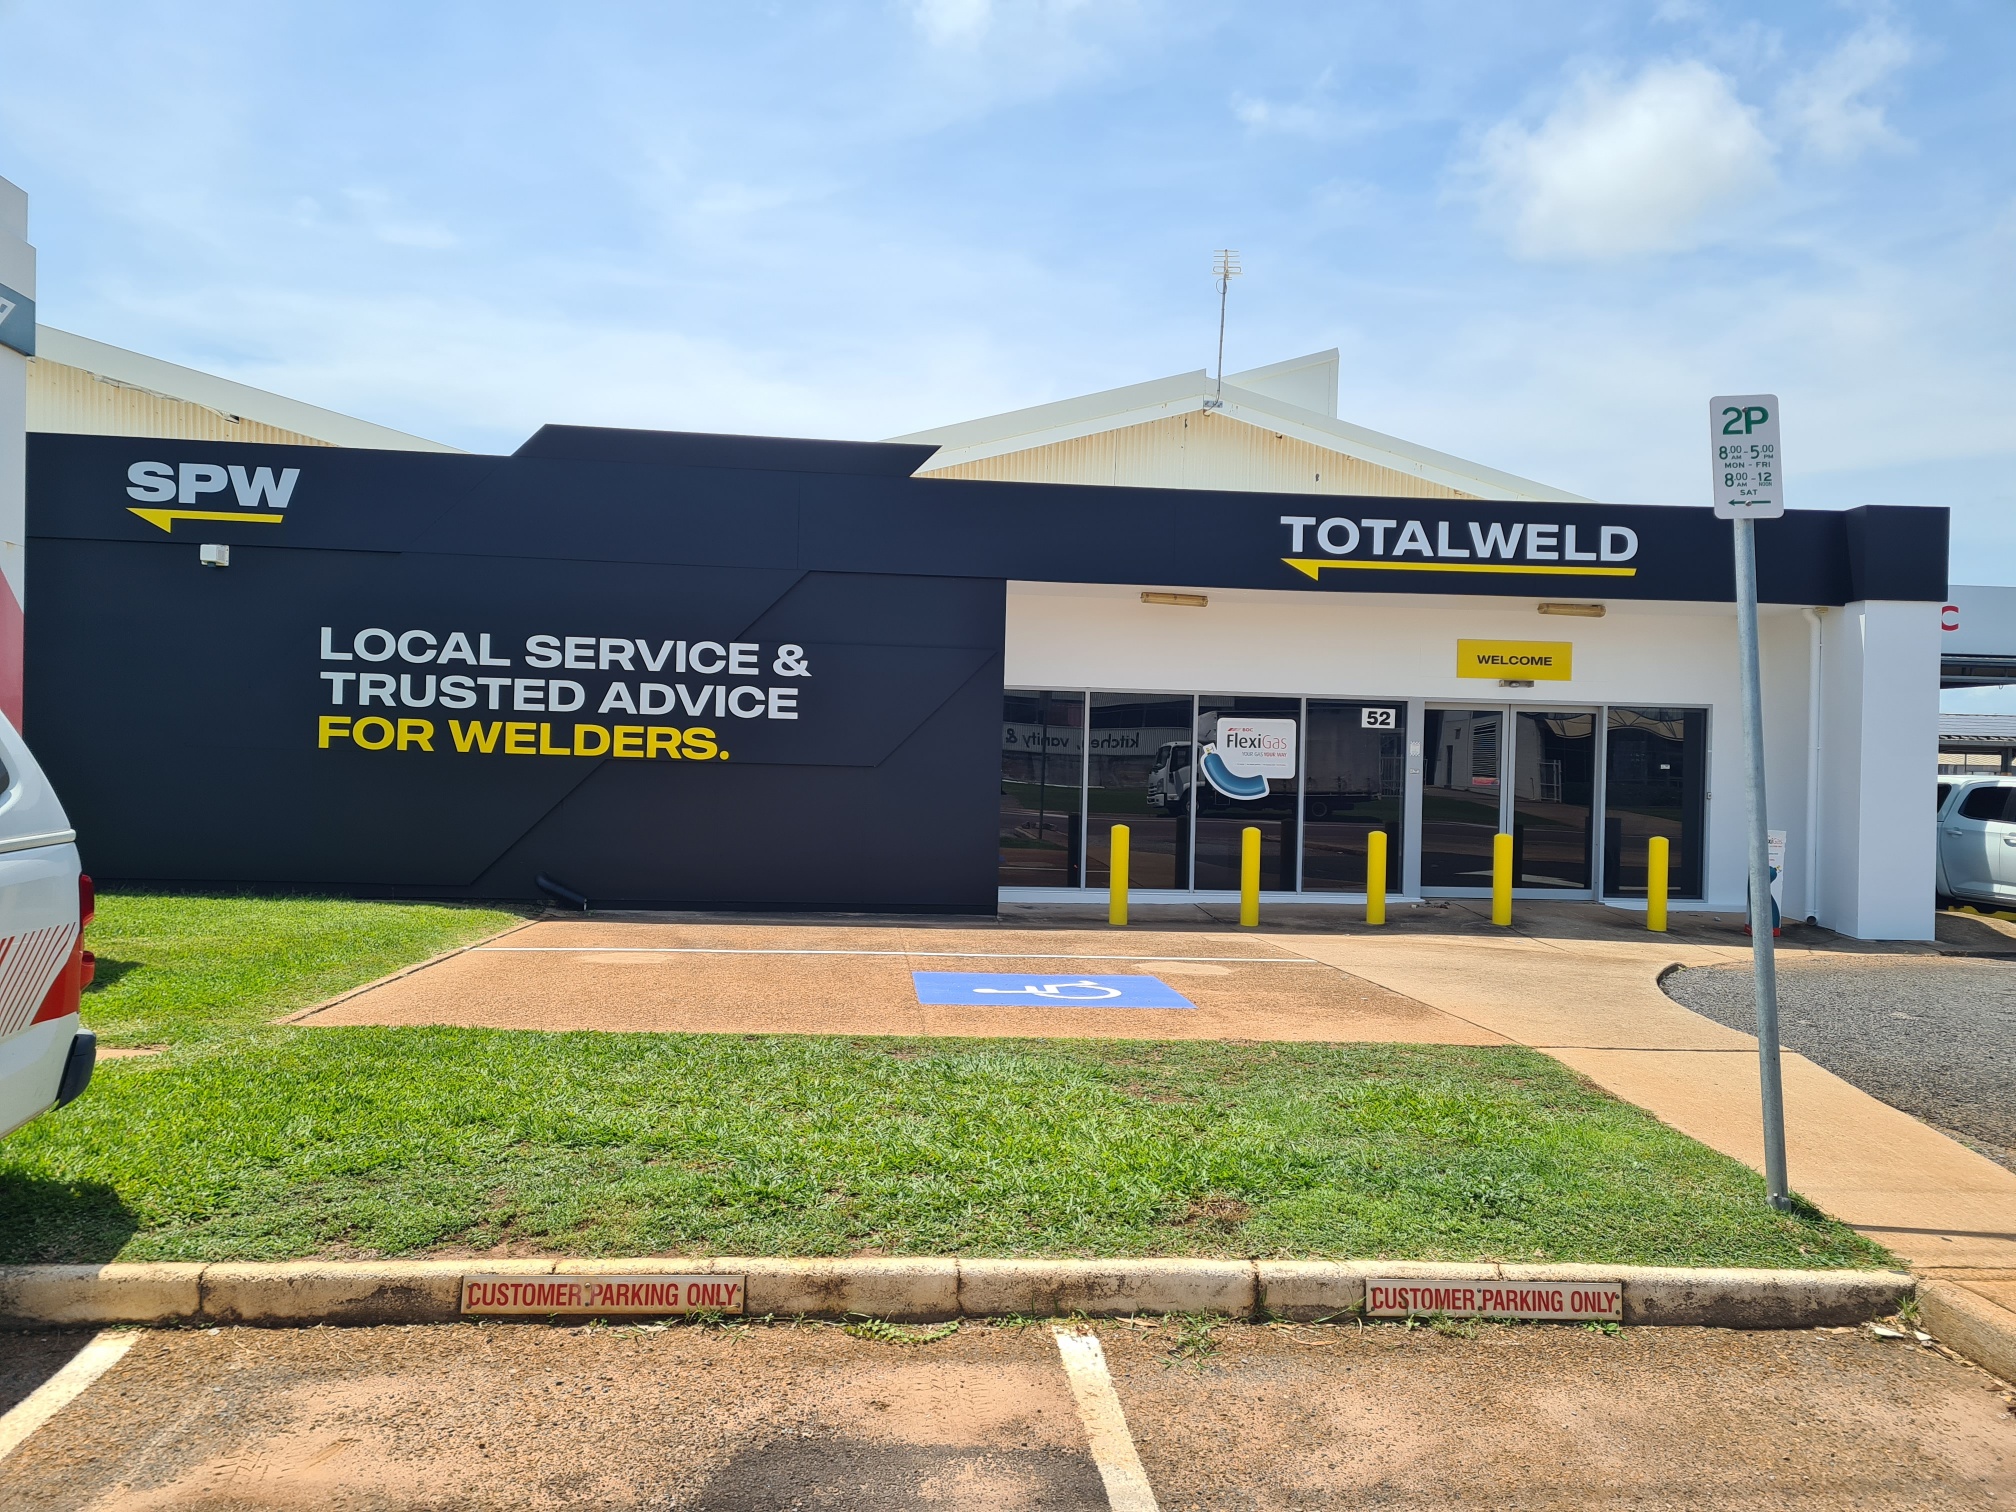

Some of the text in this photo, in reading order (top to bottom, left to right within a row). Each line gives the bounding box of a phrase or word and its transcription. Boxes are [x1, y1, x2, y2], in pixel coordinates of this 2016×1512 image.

[1722, 406, 1769, 435] 2P
[126, 460, 301, 509] SPW
[1758, 472, 1772, 481] 12
[1280, 515, 1639, 562] TOTALWELD
[320, 627, 812, 678] LOCAL SERVICE &
[1476, 654, 1553, 667] WELCOME
[320, 671, 799, 720] TRUSTED ADVICE
[1366, 711, 1392, 726] 52
[318, 715, 730, 761] FOR WELDERS.
[1226, 733, 1287, 750] FlexiGas
[468, 1282, 739, 1307] CUSTOMER PARKING ONLY
[1371, 1287, 1617, 1313] CUSTOMER PARKING ONLY
